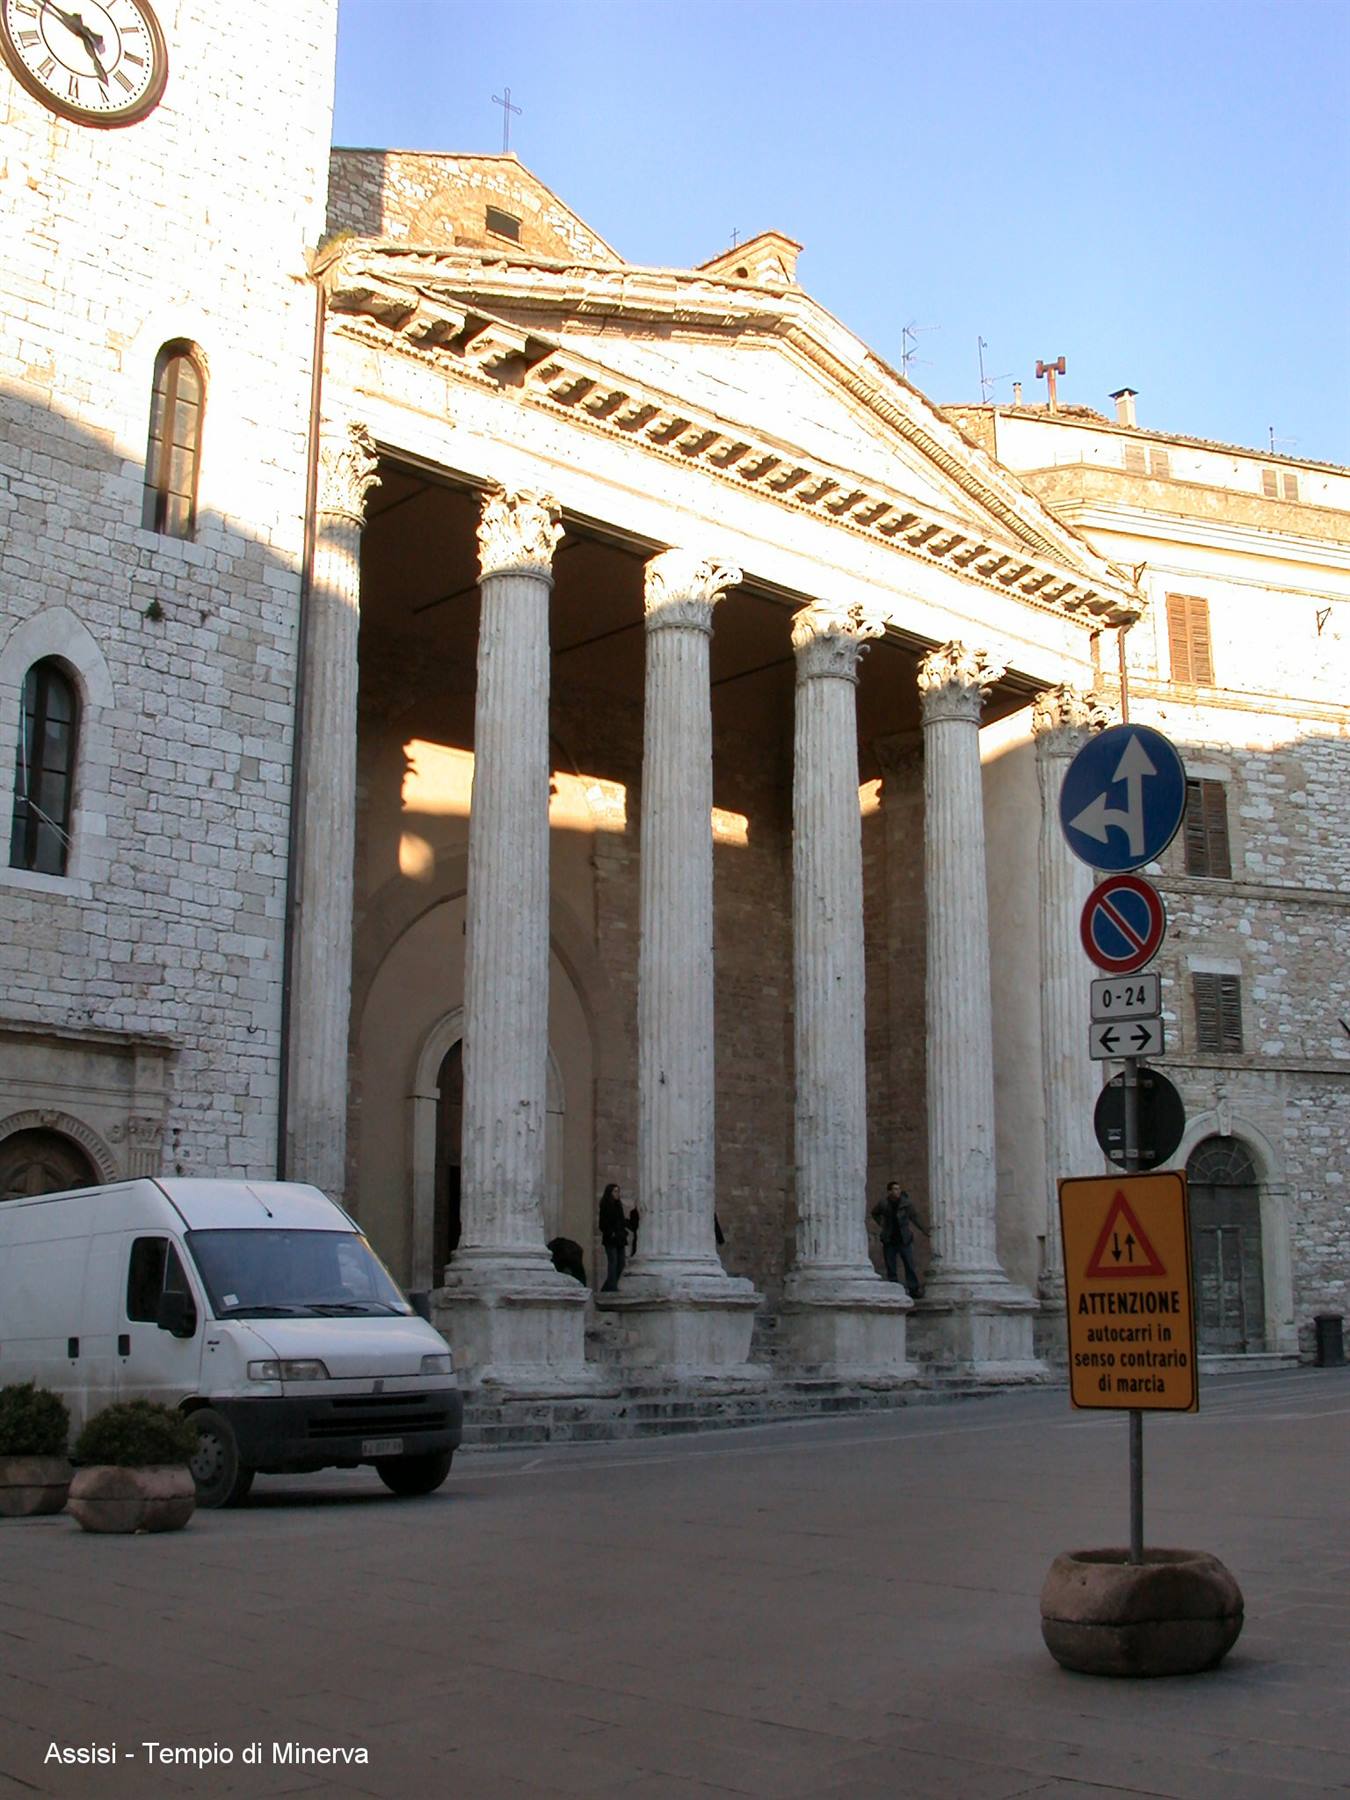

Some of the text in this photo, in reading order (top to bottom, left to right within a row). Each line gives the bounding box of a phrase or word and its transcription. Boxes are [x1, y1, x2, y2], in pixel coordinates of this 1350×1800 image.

[97, 82, 109, 103] V
[1077, 1290, 1181, 1315] ATTENZIONE
[1087, 1323, 1172, 1343] autocarri in
[1074, 1348, 1188, 1368] senso contrario
[1098, 1373, 1166, 1393] di marcia
